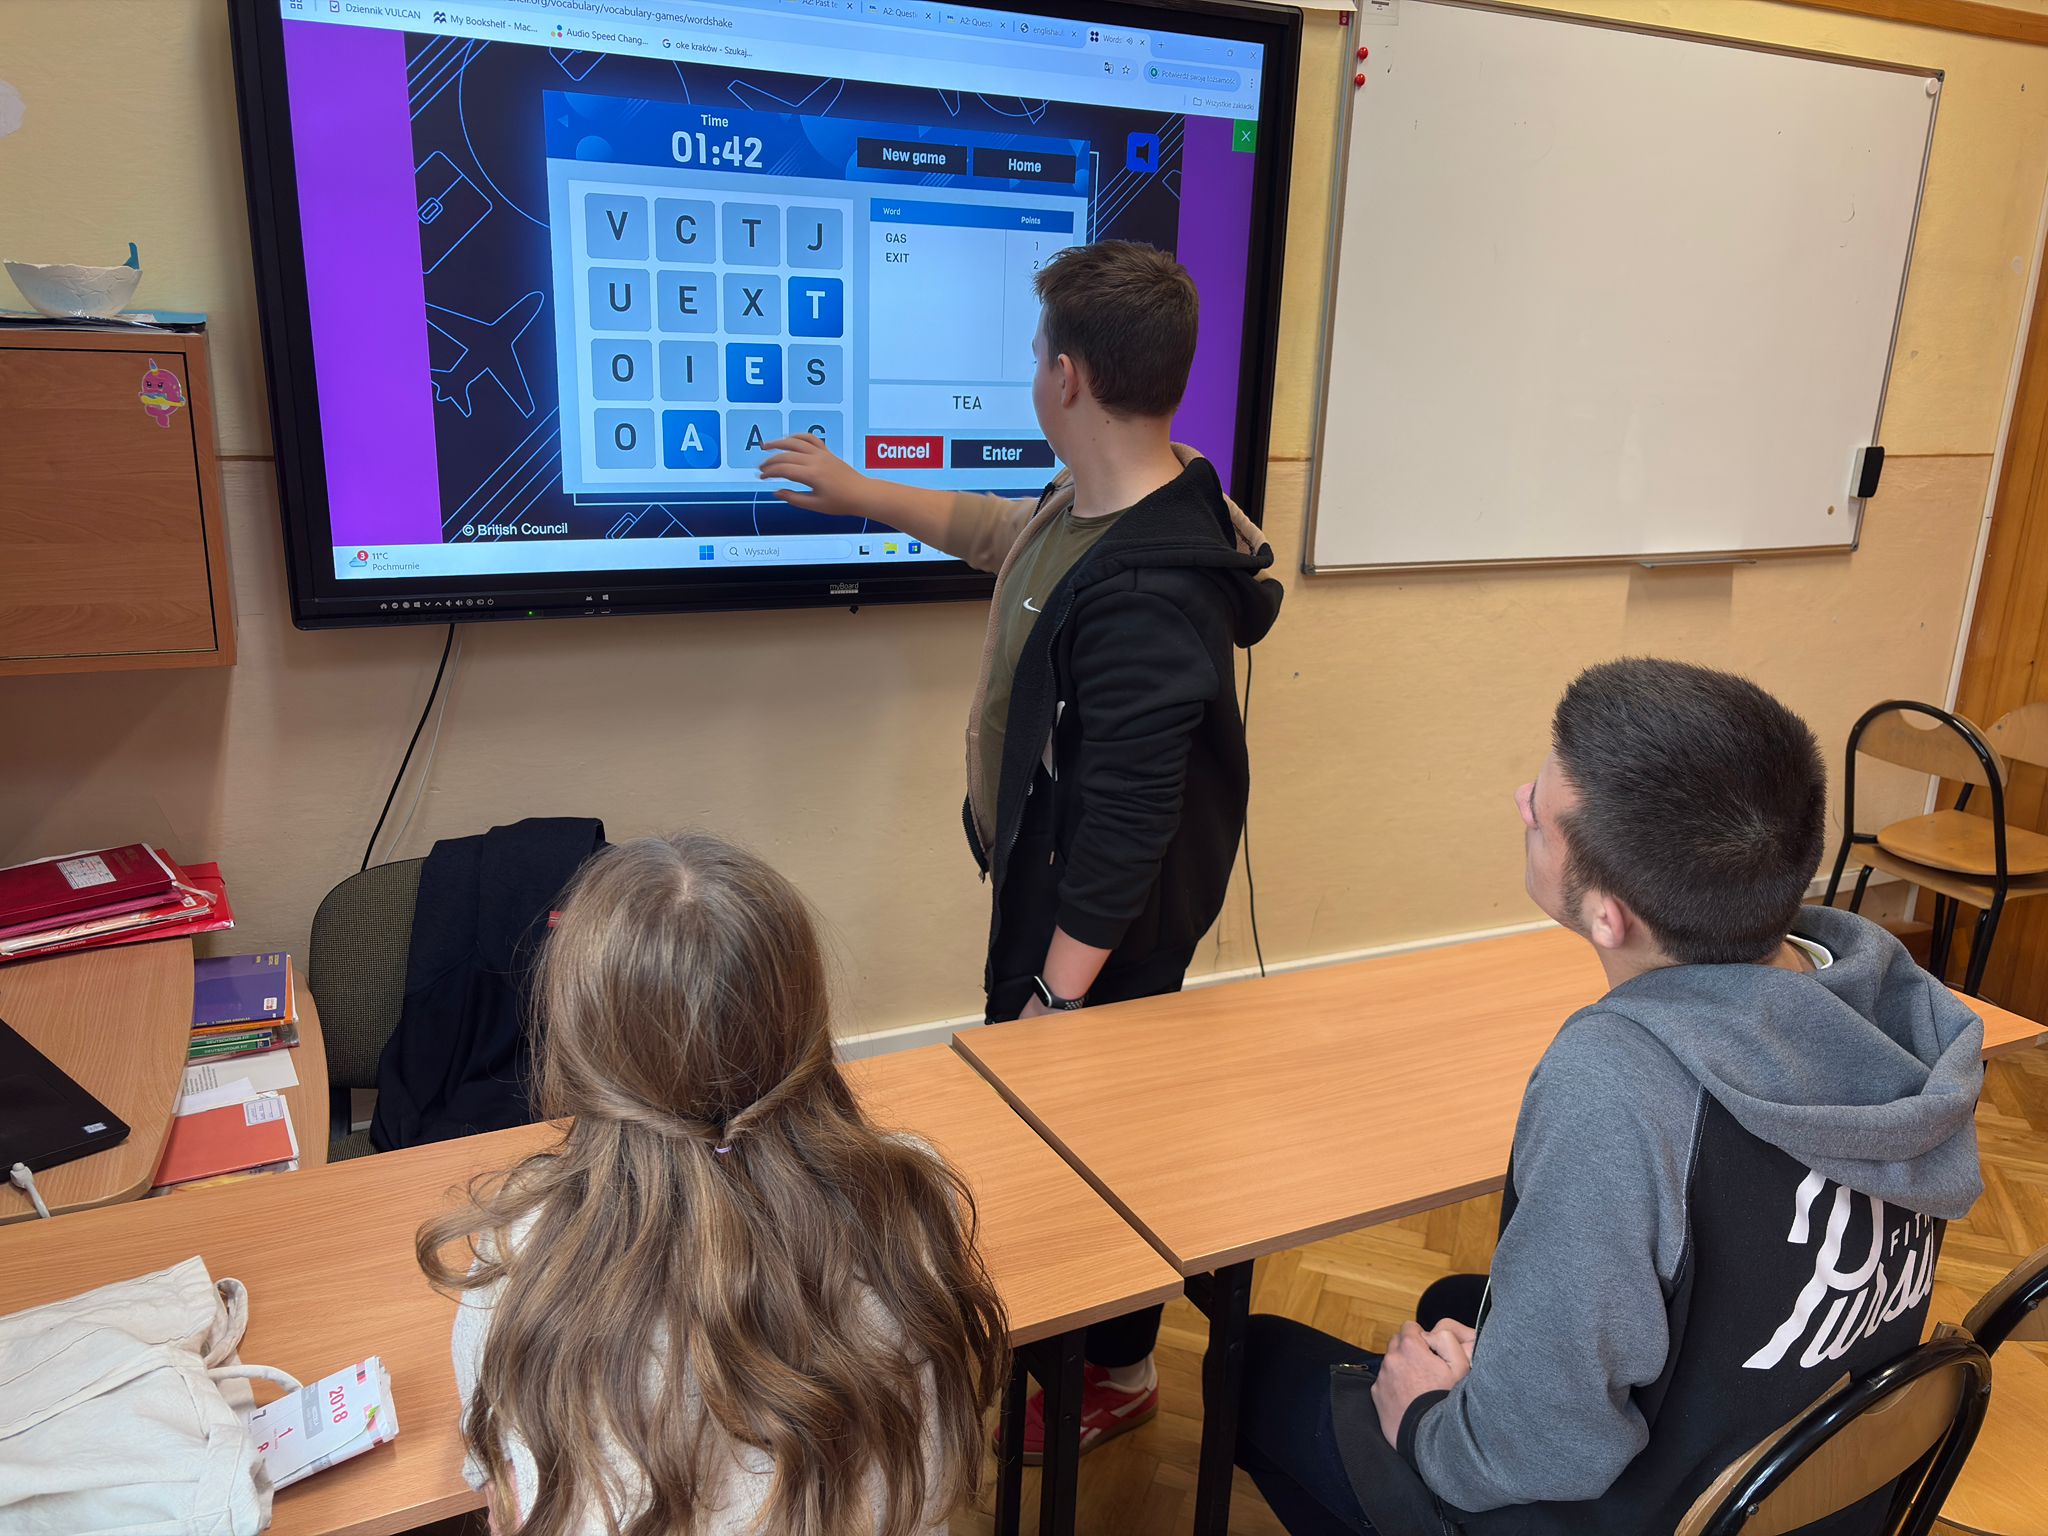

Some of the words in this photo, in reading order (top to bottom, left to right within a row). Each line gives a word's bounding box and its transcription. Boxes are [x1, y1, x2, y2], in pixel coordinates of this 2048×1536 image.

[345, 3, 383, 16] Dziennik
[384, 7, 421, 19] VULCAN
[508, 0, 733, 29] cil.org/vocabulary/vocabulary-games/wordshake
[882, 7, 894, 16] A2:
[450, 15, 464, 26] My
[466, 16, 506, 30] Bookshelf
[960, 17, 971, 25] A2:
[566, 28, 589, 39] Audio
[591, 31, 616, 43] Speed
[675, 42, 689, 50] oke
[691, 42, 718, 53] kraków
[700, 114, 729, 128] Time
[671, 131, 763, 169] 01:42
[882, 147, 910, 163] New
[912, 151, 946, 166] game
[1008, 158, 1042, 173] Home
[882, 207, 901, 216] Word
[1020, 215, 1041, 225] Points
[605, 210, 629, 241] V
[675, 214, 697, 245] C
[742, 219, 762, 248] T
[806, 223, 823, 252] J
[885, 233, 907, 244] GAS
[885, 252, 910, 264] EXIT
[1033, 260, 1039, 270] 2
[609, 283, 631, 312] U
[680, 286, 697, 315] E
[742, 288, 764, 317] X
[805, 290, 826, 319] T
[611, 354, 634, 383] O
[686, 355, 693, 383] I
[745, 357, 764, 385] E
[806, 358, 826, 386] S
[952, 395, 983, 410] TEA
[615, 423, 637, 451] O
[680, 423, 704, 452] A
[745, 425, 766, 452] A
[876, 443, 930, 460] Cancel
[982, 445, 1022, 462] Enter
[477, 524, 518, 536] British
[521, 522, 568, 535] Council
[744, 546, 780, 558] Wyszukaj
[372, 562, 420, 571] Pochmurnie
[830, 582, 859, 590] myBoard
[328, 1385, 349, 1424] 2018
